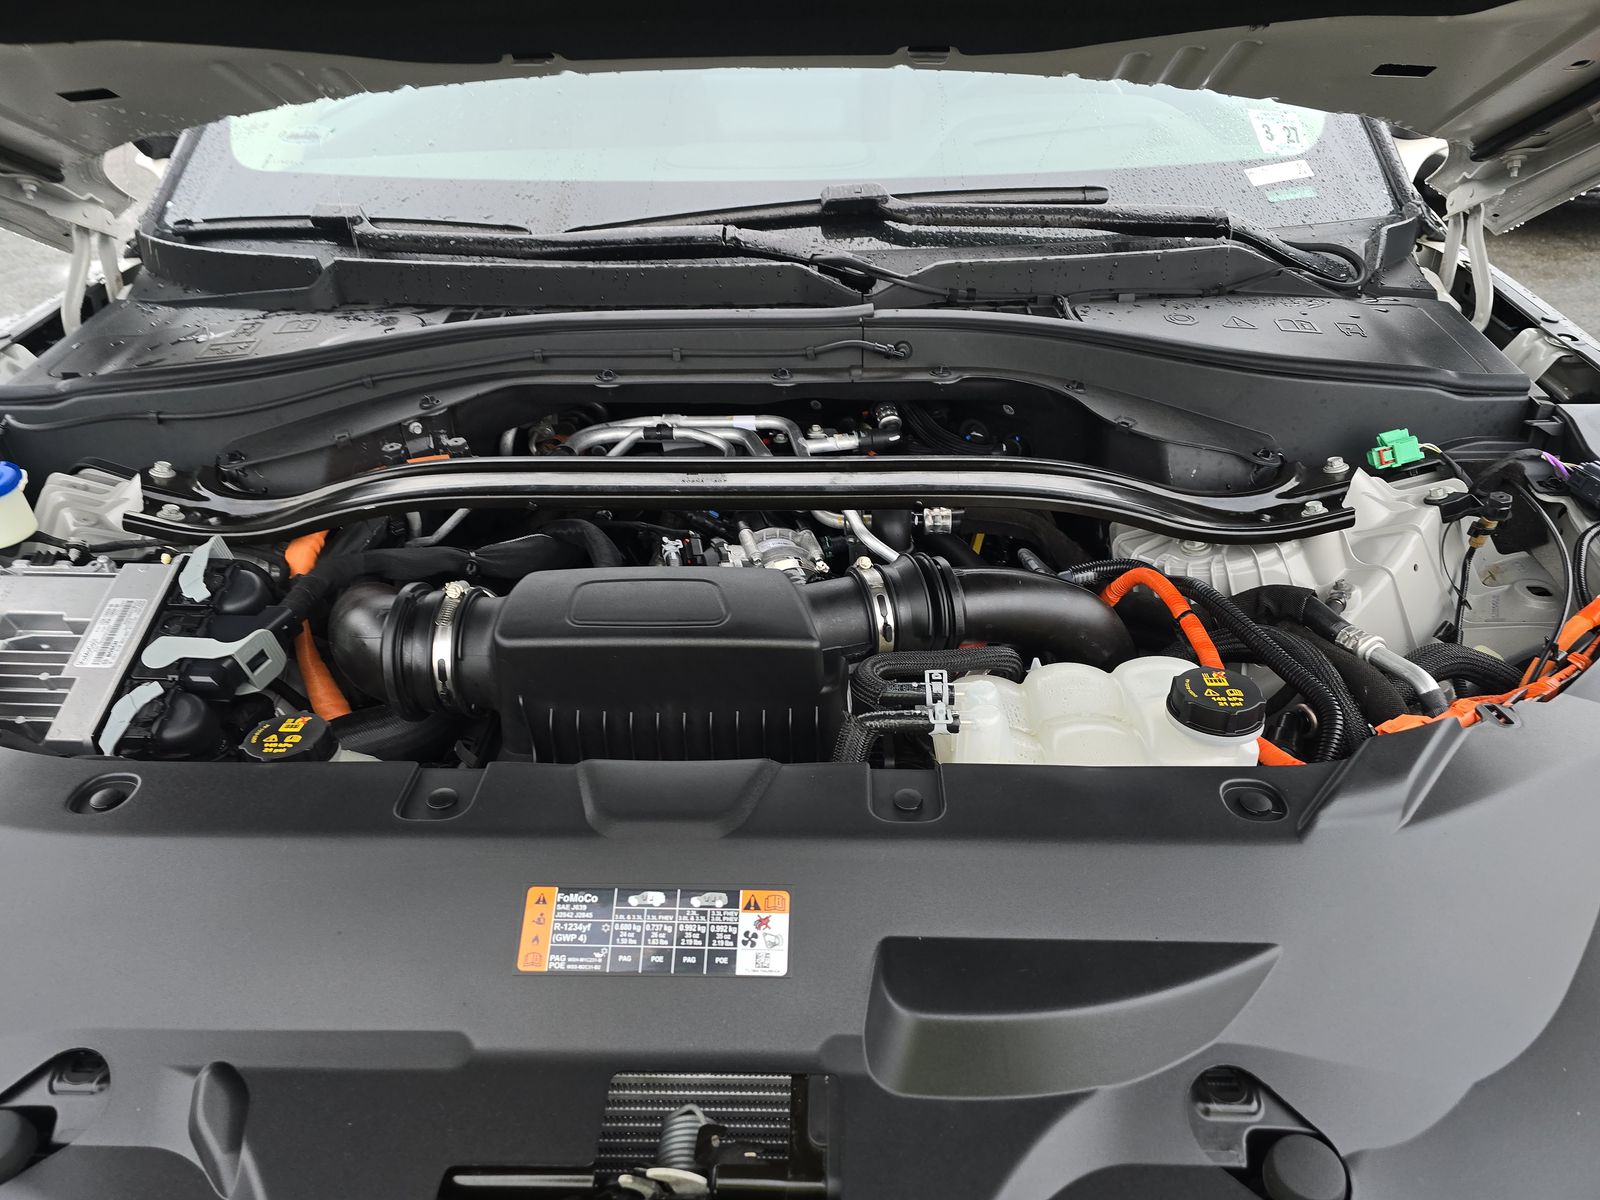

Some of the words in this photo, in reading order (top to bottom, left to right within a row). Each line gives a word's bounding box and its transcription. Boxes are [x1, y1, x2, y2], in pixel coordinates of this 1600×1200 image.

[1262, 124, 1274, 142] 3
[1282, 125, 1300, 144] 27
[557, 893, 598, 903] FoMoCo
[554, 923, 592, 932] R-1234yf
[633, 924, 641, 932] kg
[664, 925, 673, 933] kg
[698, 925, 706, 934] kg
[728, 926, 737, 934] kg
[552, 934, 577, 943] (GWP
[578, 934, 587, 943] 4)
